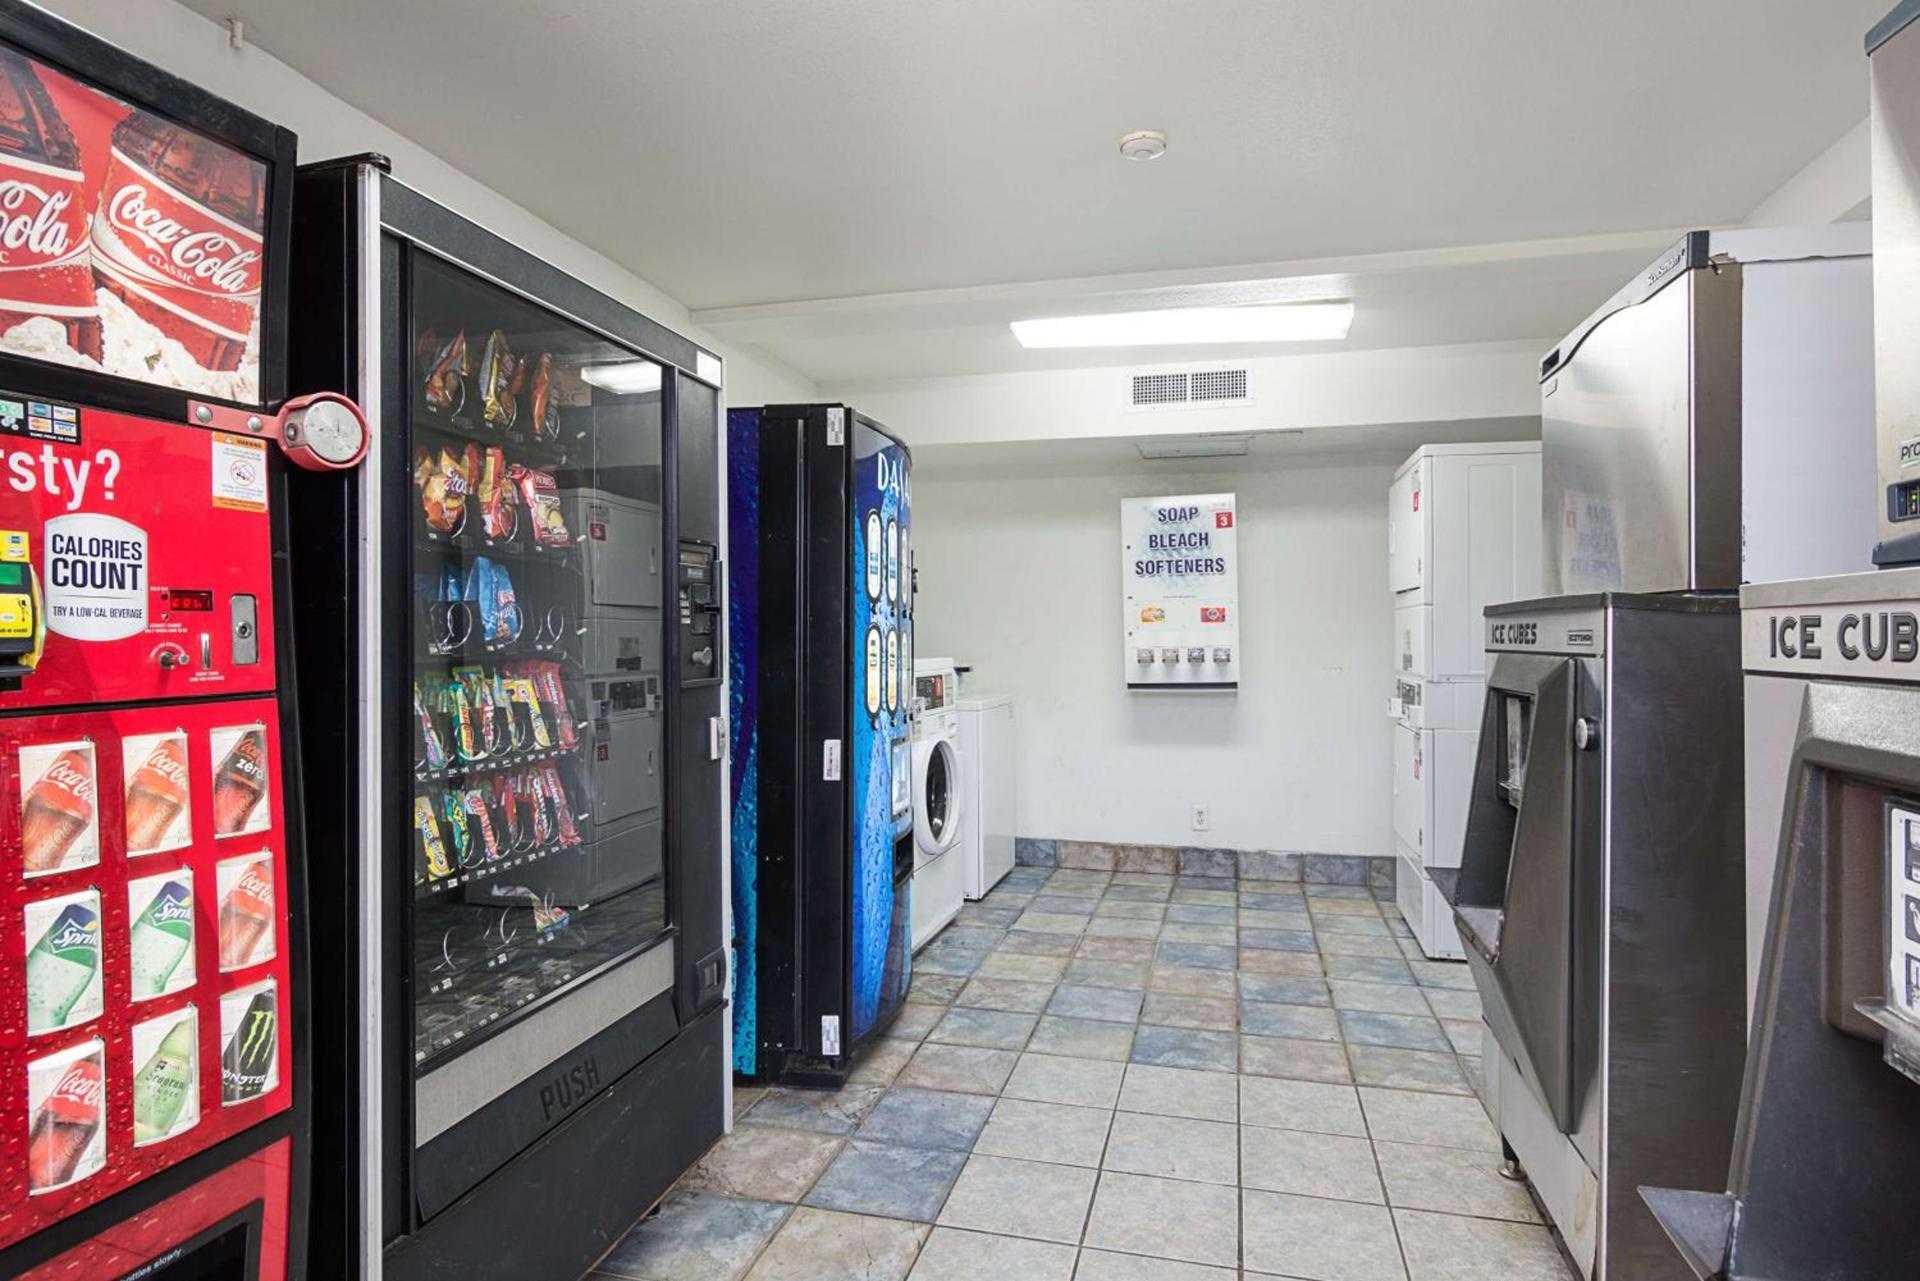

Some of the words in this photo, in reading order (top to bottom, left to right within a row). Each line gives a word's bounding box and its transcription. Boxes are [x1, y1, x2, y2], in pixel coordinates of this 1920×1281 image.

[109, 184, 263, 293] Coca-Cola
[148, 253, 195, 285] CLASSIC
[1158, 507, 1197, 522] SOAP
[1220, 516, 1229, 526] 3
[52, 533, 142, 561] CALORIES
[1149, 532, 1208, 547] BLEACH
[52, 557, 142, 590] COUNT
[1135, 557, 1224, 575] SOFTENERS
[53, 605, 68, 617] TRY
[69, 606, 75, 617] A
[76, 607, 107, 618] LOW-CAL
[109, 608, 143, 619] BEVERAGE
[1492, 624, 1506, 645] ICE
[1508, 623, 1537, 645] CUBES
[1770, 615, 1822, 660] ICE
[236, 758, 265, 780] zero
[540, 1055, 600, 1122] PUSH
[153, 1249, 182, 1269] slowly
